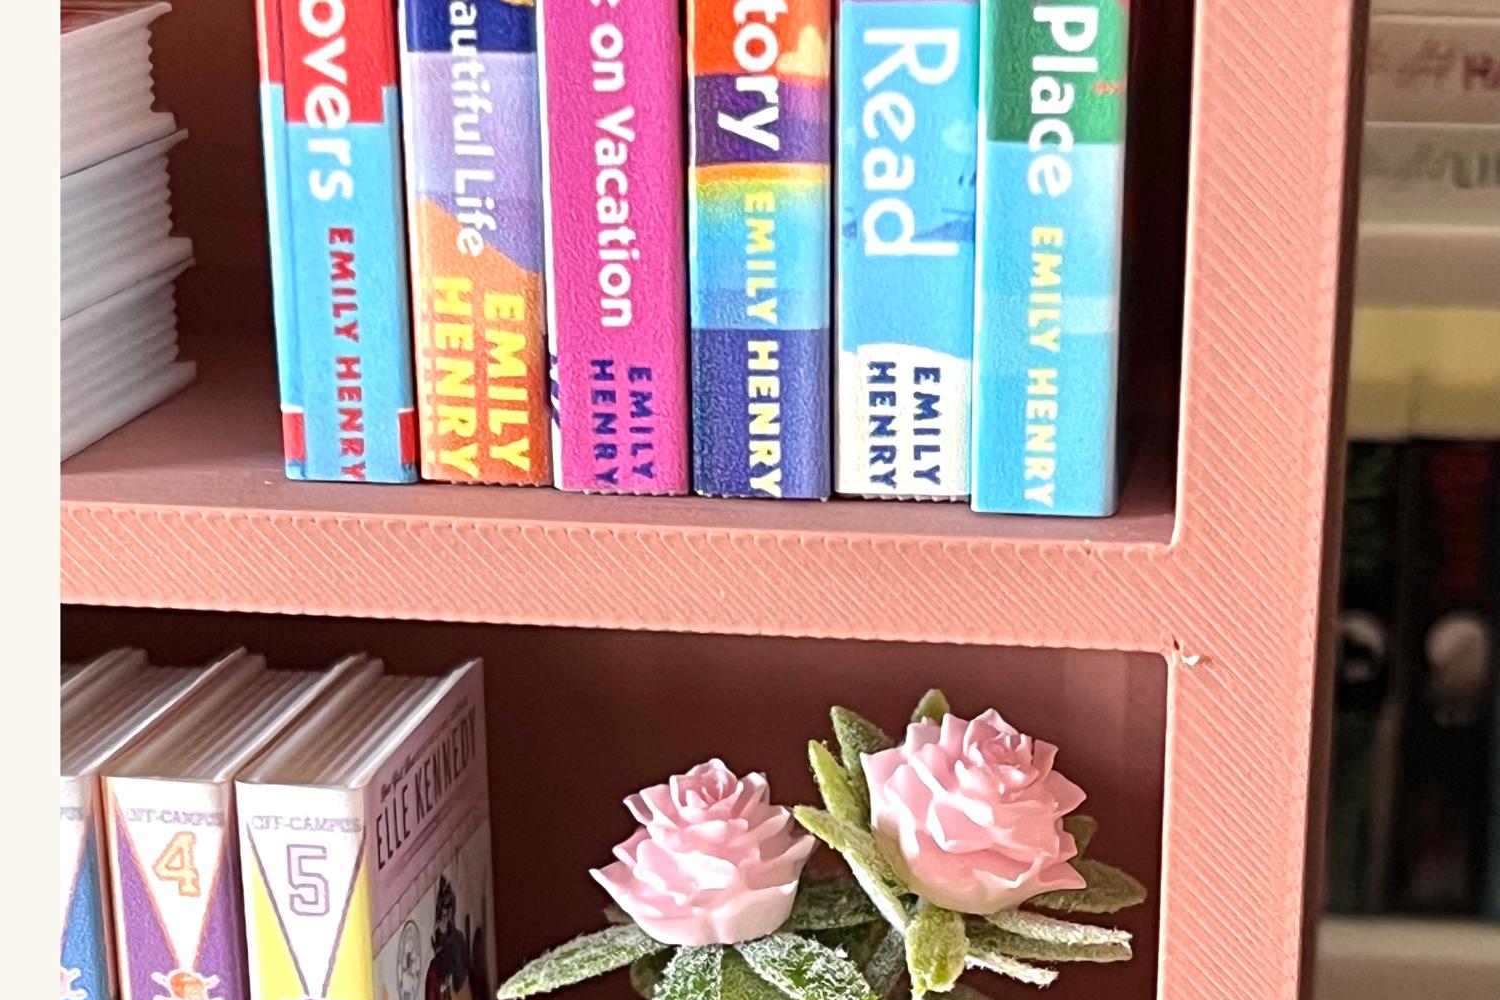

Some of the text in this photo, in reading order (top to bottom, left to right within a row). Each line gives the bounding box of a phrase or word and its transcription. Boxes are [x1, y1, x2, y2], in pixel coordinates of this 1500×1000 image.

[590, 23, 624, 93] on
[1026, 6, 1099, 197] Place
[454, 170, 497, 258] Life
[593, 105, 640, 327] Vacation
[862, 27, 961, 257] Read
[327, 227, 366, 479] EMILY HENRY
[433, 275, 480, 479] HENRY
[484, 292, 532, 473] EMILY
[590, 359, 619, 487] HENRY
[627, 366, 654, 479] EMILY
[744, 192, 782, 498] EMILY HENRY
[868, 361, 897, 489] HENRY
[912, 365, 941, 486] EMILY
[1024, 226, 1064, 507] EMILY HENRY
[153, 831, 202, 897] 4
[376, 784, 410, 871] ELLE
[415, 704, 476, 824] KENNEDY
[287, 843, 330, 916] 5
